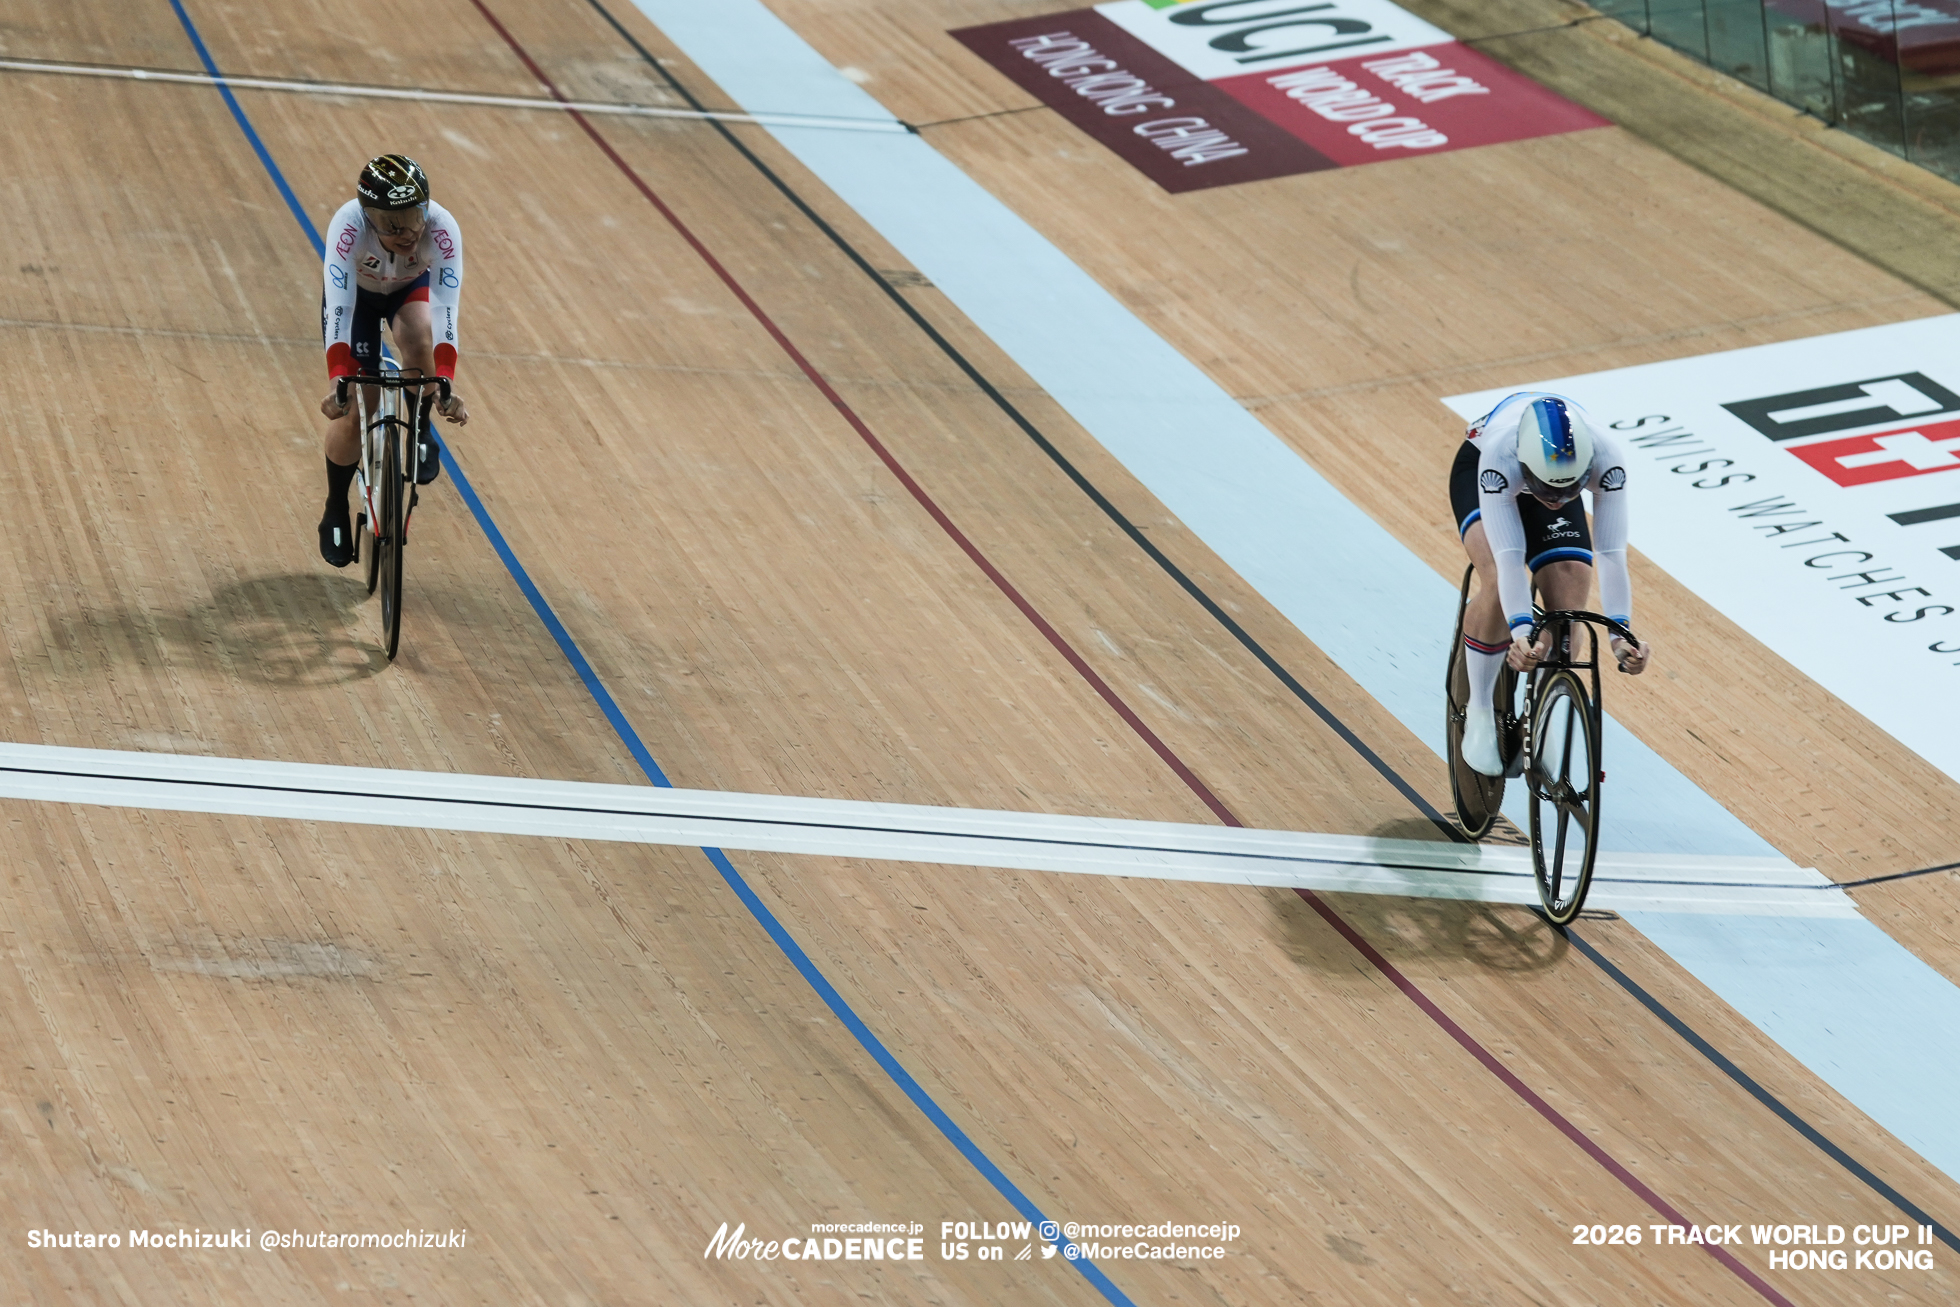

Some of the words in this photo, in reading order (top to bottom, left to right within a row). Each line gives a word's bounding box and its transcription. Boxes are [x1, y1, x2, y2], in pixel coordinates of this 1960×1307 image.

[1168, 0, 1395, 64] UCI
[1008, 31, 1117, 77] HONG
[1064, 69, 1175, 115] KONG
[1133, 117, 1249, 166] CHINA
[1265, 66, 1396, 122] WORLD
[1347, 117, 1449, 150] CUP
[1361, 51, 1490, 103] TRACK
[1542, 531, 1581, 542] LLOYDS
[1609, 414, 1756, 490] SWISS
[1727, 495, 1955, 623] WATCHES
[1523, 683, 1533, 771] LOTUS
